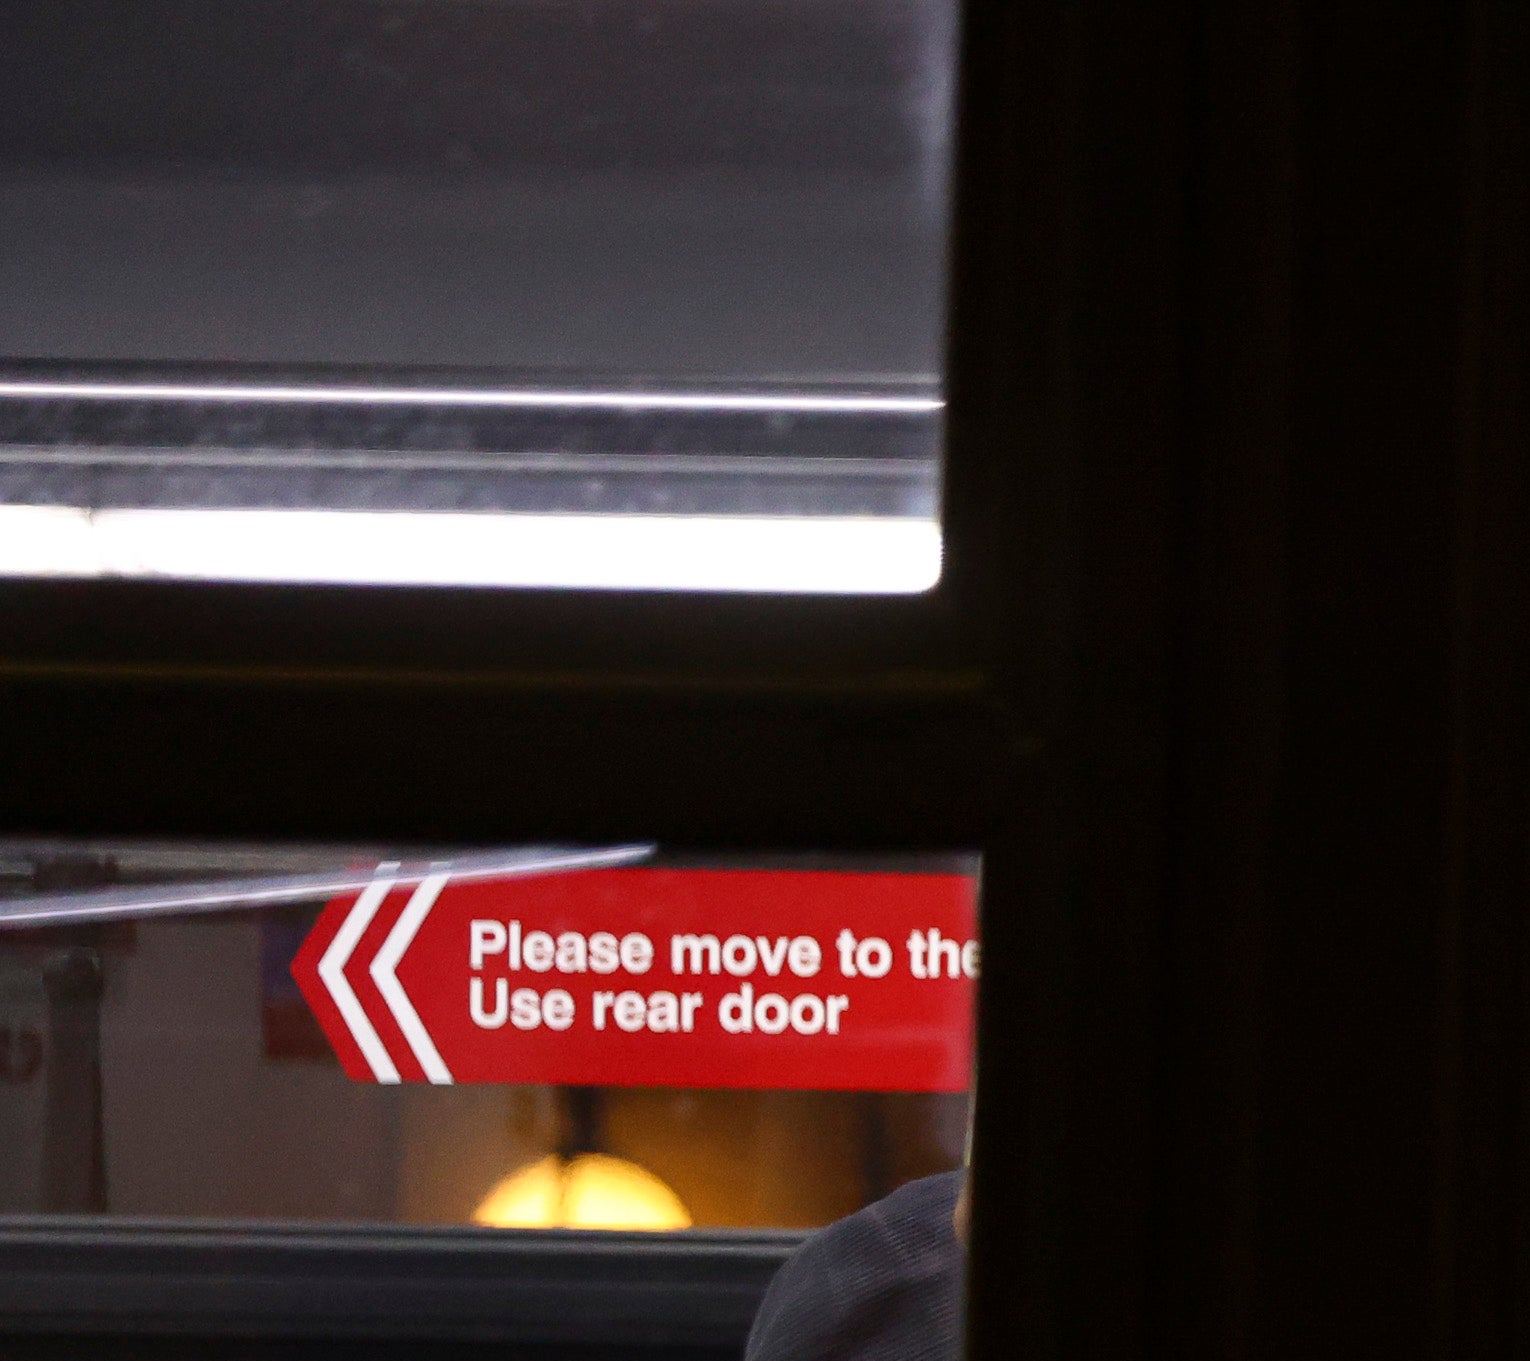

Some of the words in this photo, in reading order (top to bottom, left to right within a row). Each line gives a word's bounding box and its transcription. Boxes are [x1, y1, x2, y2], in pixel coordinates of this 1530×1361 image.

[469, 919, 654, 973] Please
[670, 936, 821, 976] move
[838, 928, 892, 978] to
[469, 977, 575, 1030] Use
[592, 991, 702, 1032] rear
[718, 983, 849, 1035] door
